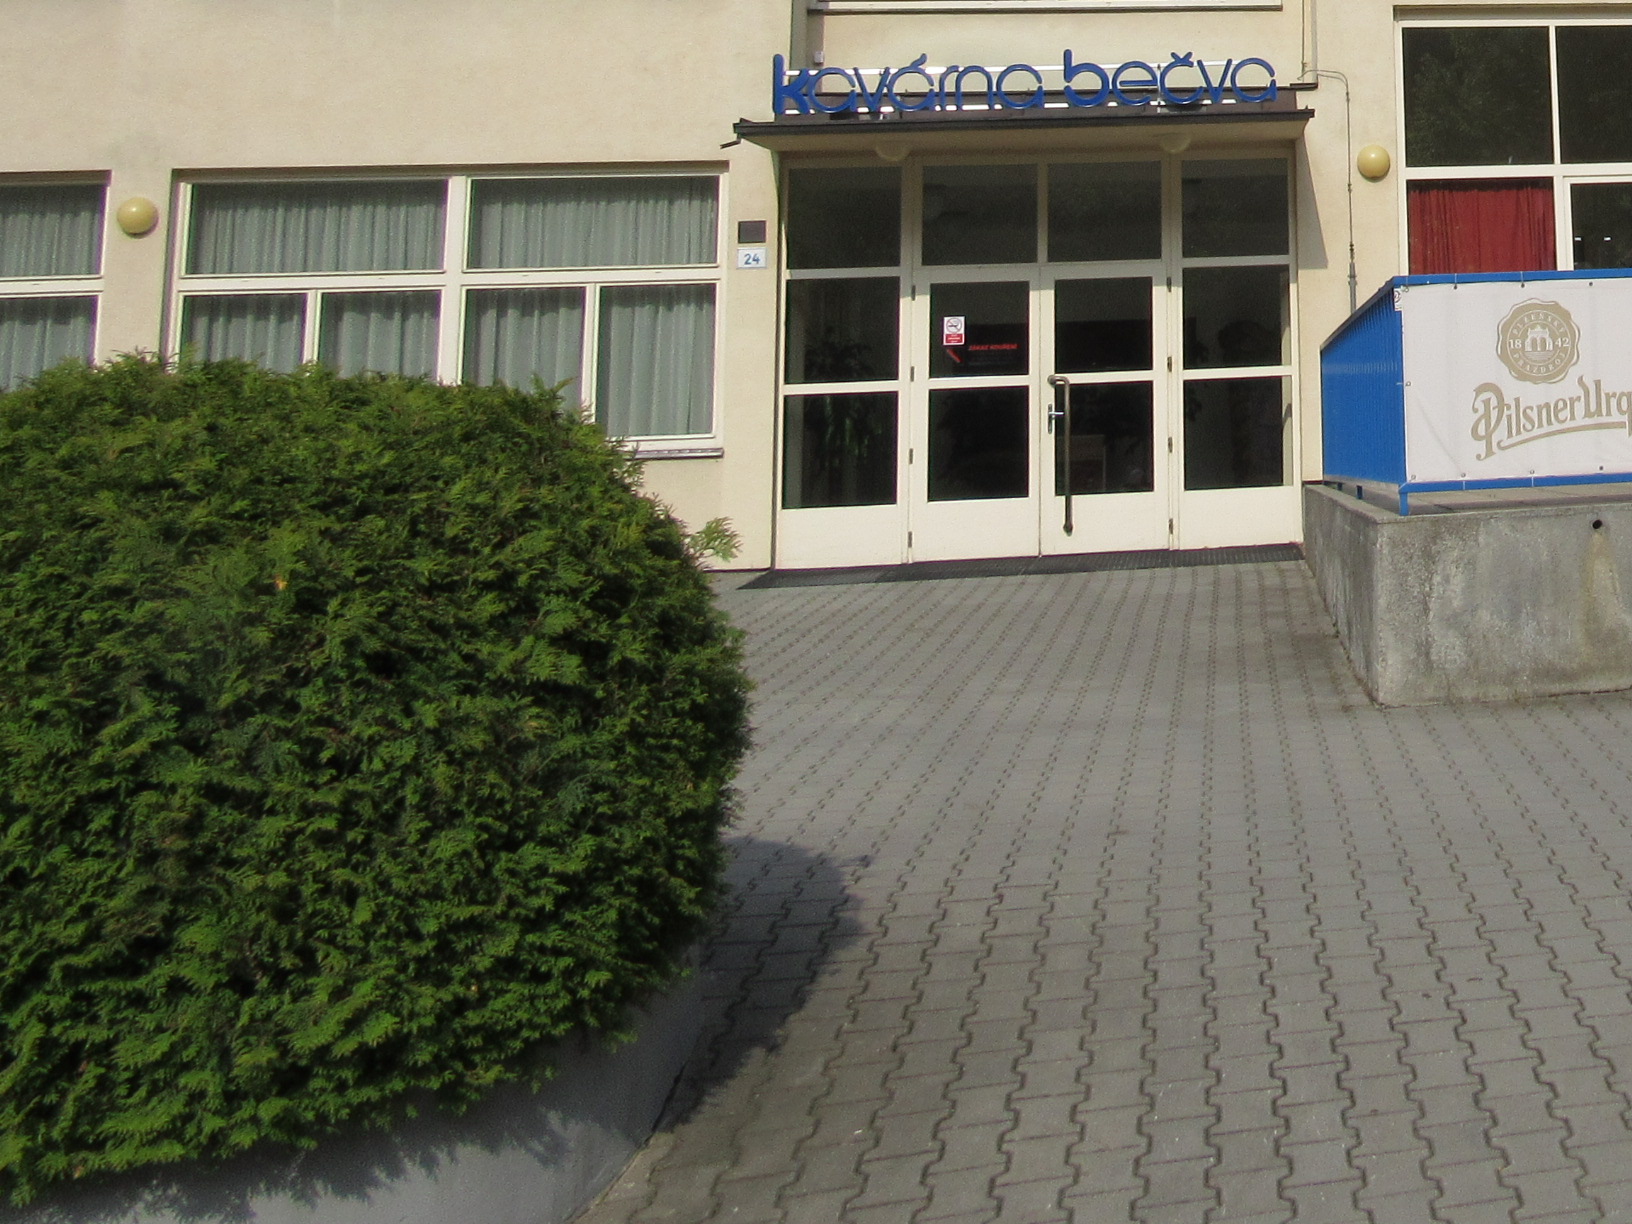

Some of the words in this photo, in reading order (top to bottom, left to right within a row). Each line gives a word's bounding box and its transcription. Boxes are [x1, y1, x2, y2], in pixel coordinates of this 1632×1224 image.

[773, 53, 1044, 114] kavárna
[1063, 48, 1278, 108] bečva
[743, 253, 761, 265] 24
[1508, 338, 1522, 349] 18
[1554, 337, 1570, 348] 42
[1470, 381, 1582, 462] Pilsner
